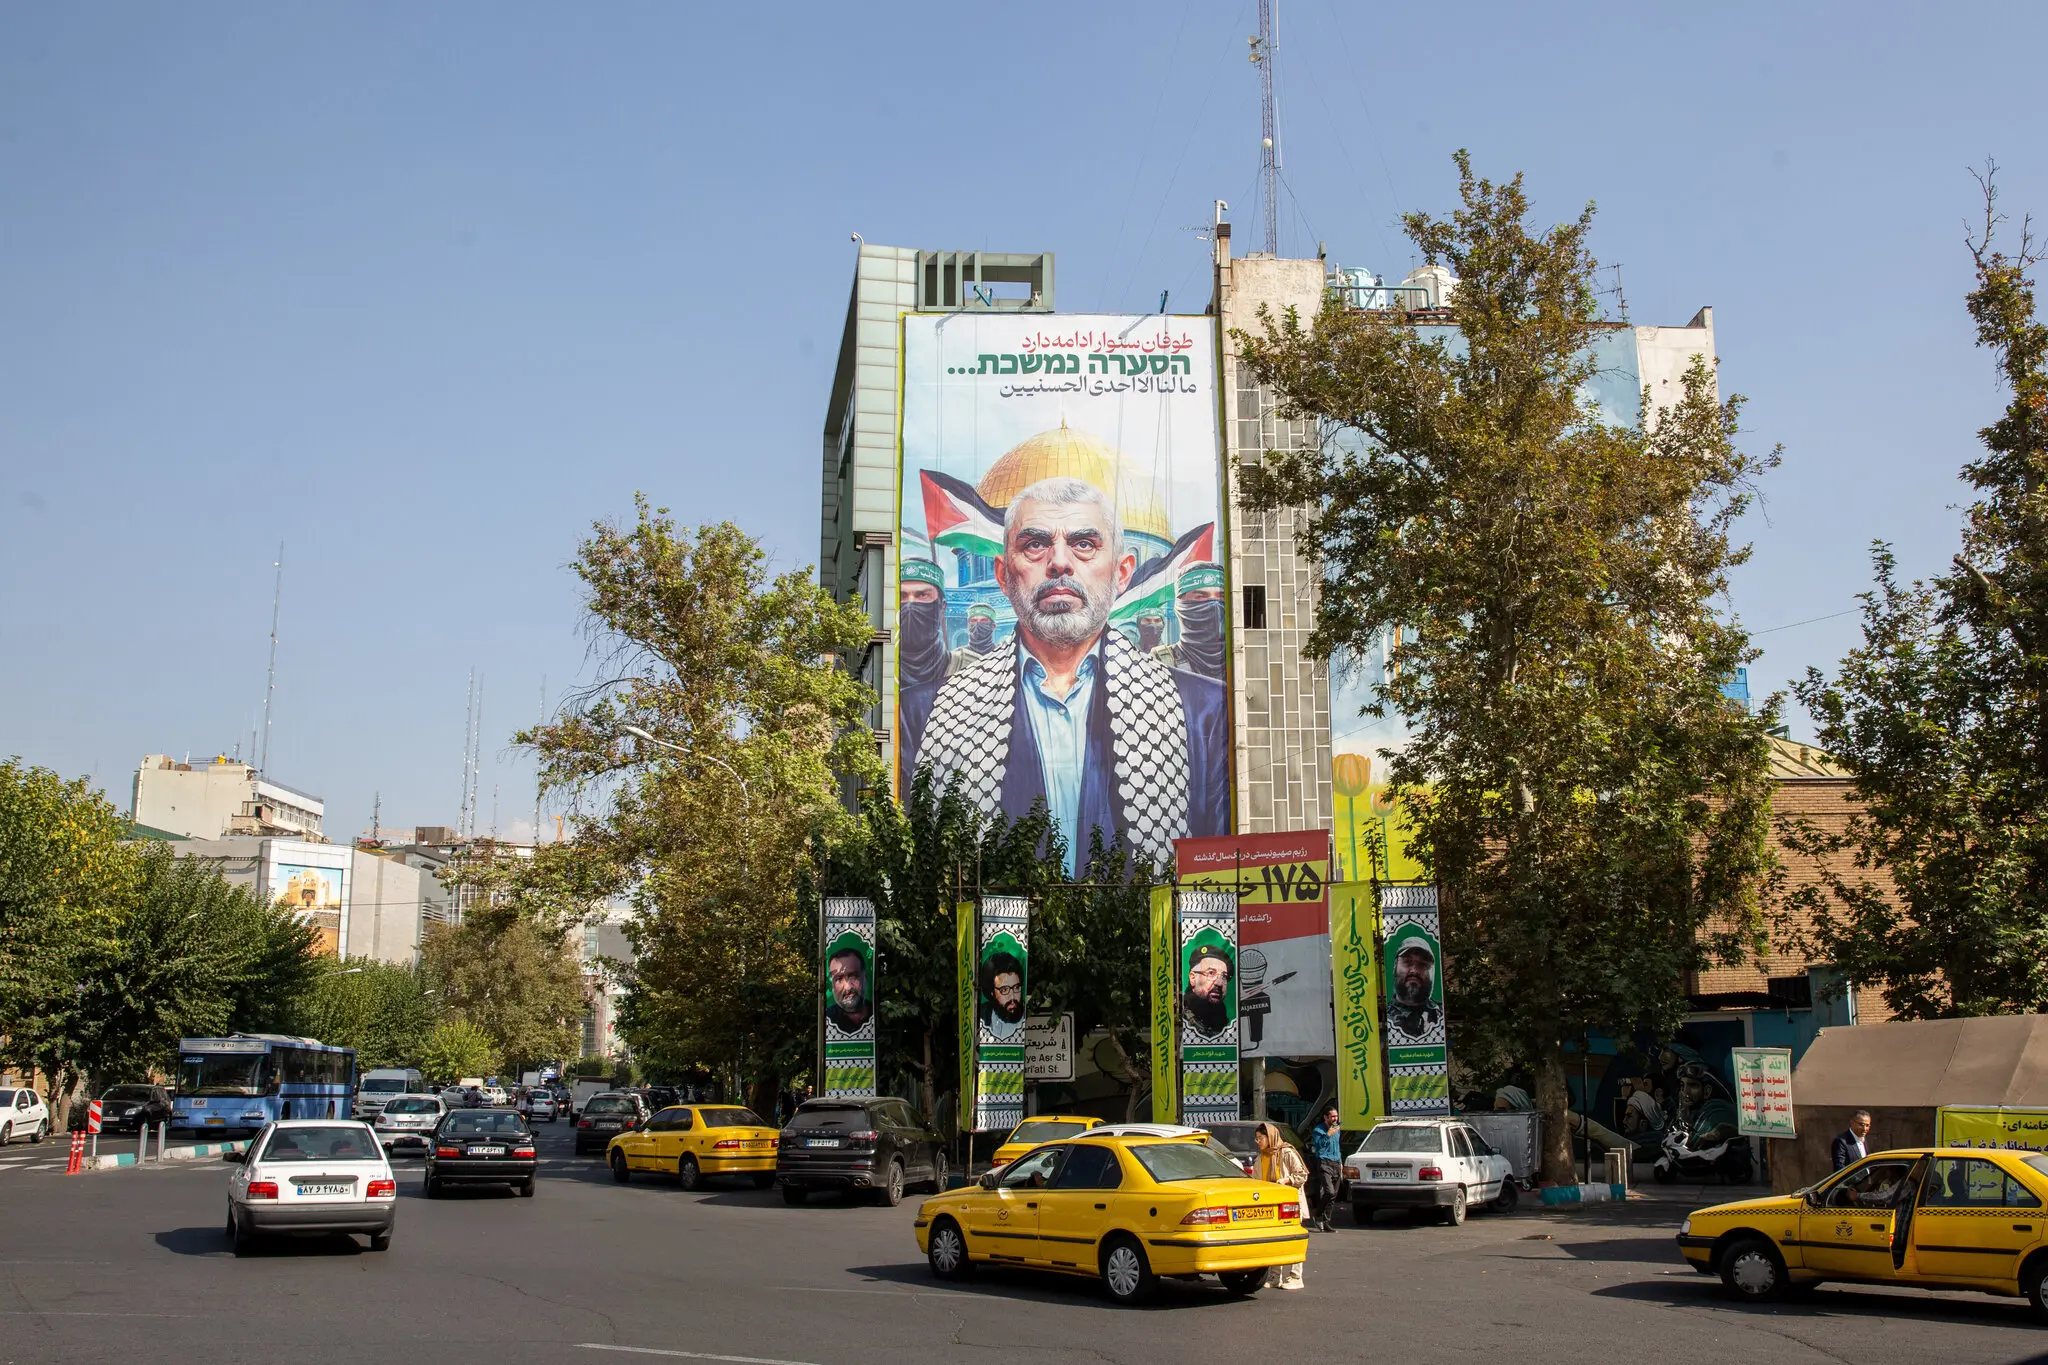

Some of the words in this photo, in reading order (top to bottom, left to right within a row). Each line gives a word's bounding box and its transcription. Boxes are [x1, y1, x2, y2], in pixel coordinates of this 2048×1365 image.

[1022, 331, 1051, 353] دارد
[1052, 331, 1093, 349] ادامه
[1093, 331, 1141, 354] سنوار
[1141, 331, 1193, 354] طوفان
[1088, 353, 1191, 376] הסערה
[1156, 376, 1176, 393] لنا
[1179, 376, 1197, 394] ما
[1193, 852, 1217, 862] گذشته
[1250, 848, 1293, 861] صهیونیستی
[1292, 846, 1308, 859] رژیم
[1261, 862, 1321, 903] ۱۷۵
[1240, 915, 1249, 923] اس
[1343, 897, 1370, 973] حزب
[1342, 966, 1368, 1005] الله
[1038, 1053, 1054, 1062] Asr
[1055, 1053, 1067, 1062] St.
[1769, 1055, 1787, 1070] الله
[1344, 1042, 1370, 1116] است
[303, 1185, 314, 1193] ۸۷
